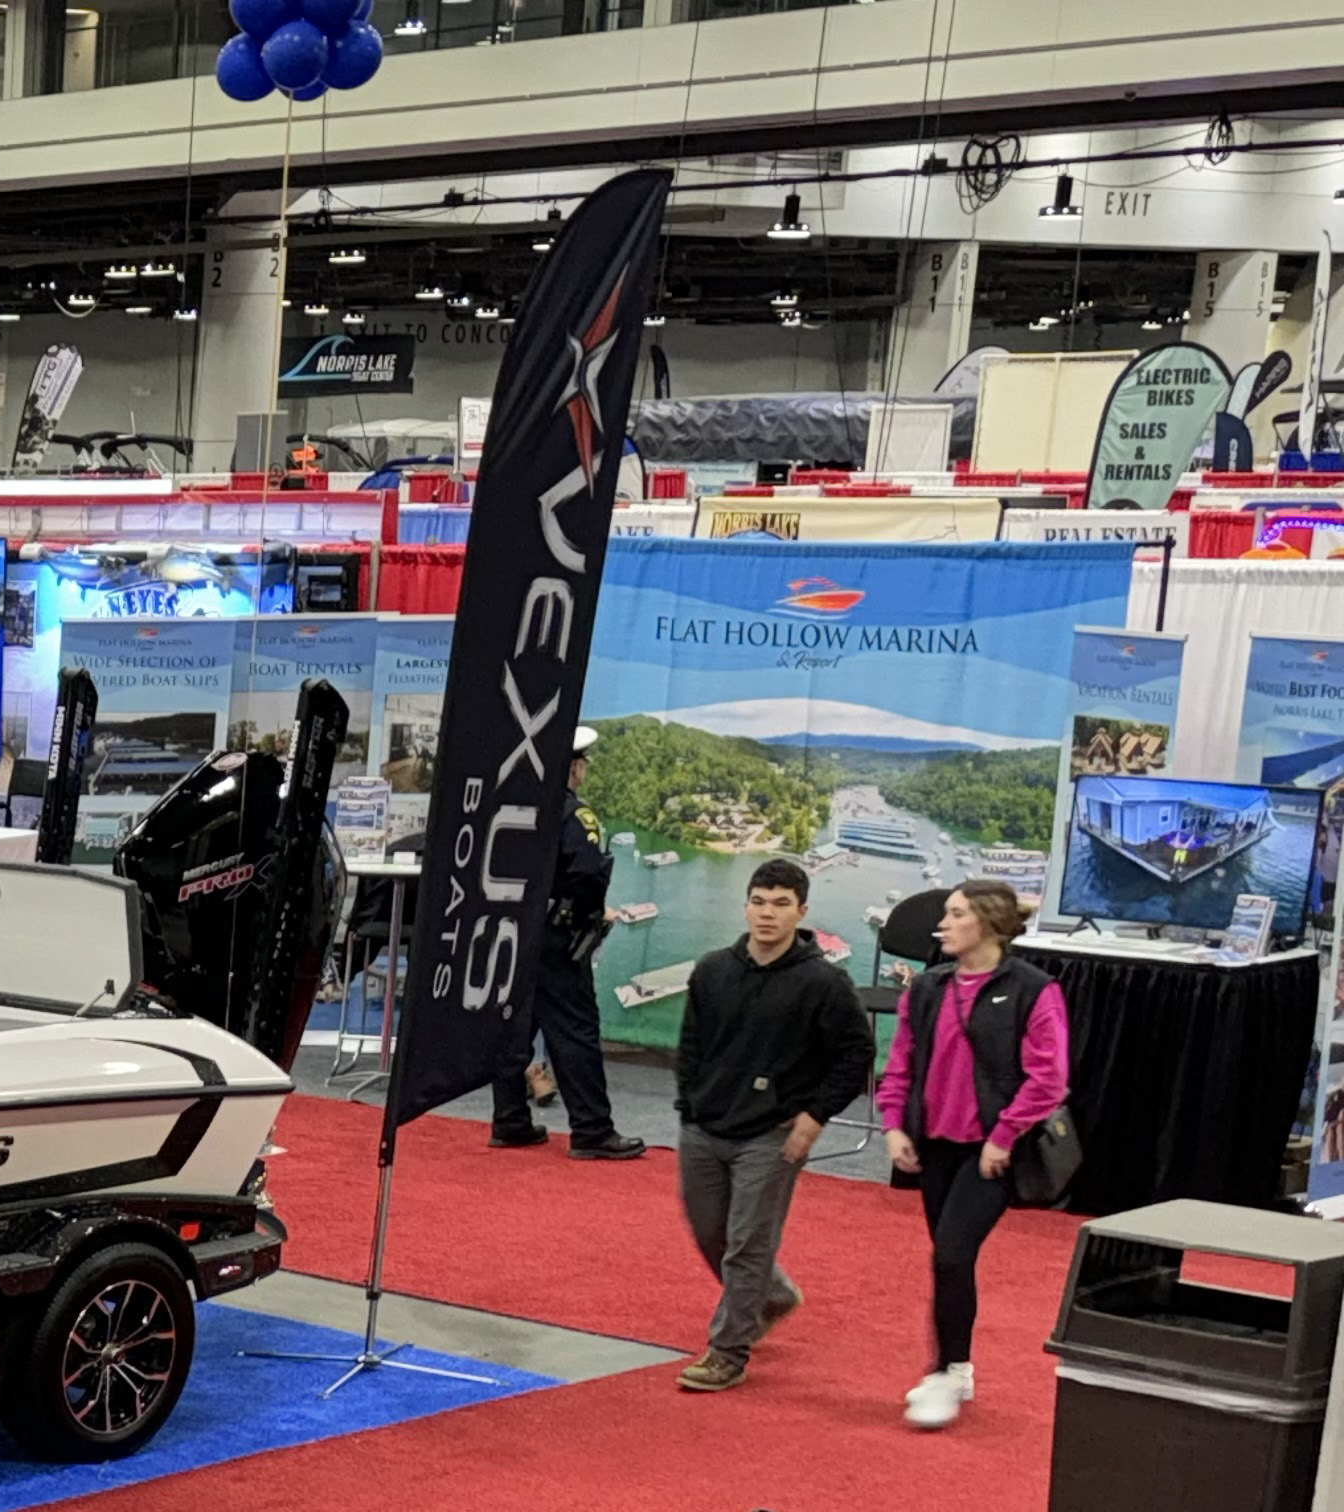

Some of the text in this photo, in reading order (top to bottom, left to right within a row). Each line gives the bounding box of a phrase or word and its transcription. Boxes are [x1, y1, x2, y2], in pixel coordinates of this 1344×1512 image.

[1103, 190, 1152, 218] EXIT
[316, 353, 398, 374] NORRIS LAKE
[1135, 367, 1211, 386] ELECTRIC
[1146, 389, 1195, 407] BIKES
[1118, 422, 1167, 440] SALES
[1134, 445, 1146, 460] &
[1103, 463, 1172, 482] RENTALS
[655, 615, 980, 654] FLAT HOLLOW MARINA
[73, 655, 112, 667] WIDE
[118, 654, 195, 668] SELECTION
[249, 662, 363, 676] BOAT RENTALS
[141, 673, 178, 687] BOAT
[182, 673, 220, 687] SLIPS
[1288, 681, 1318, 698] BEST
[462, 452, 605, 1012] VEXUS
[432, 777, 484, 999] BOATS
